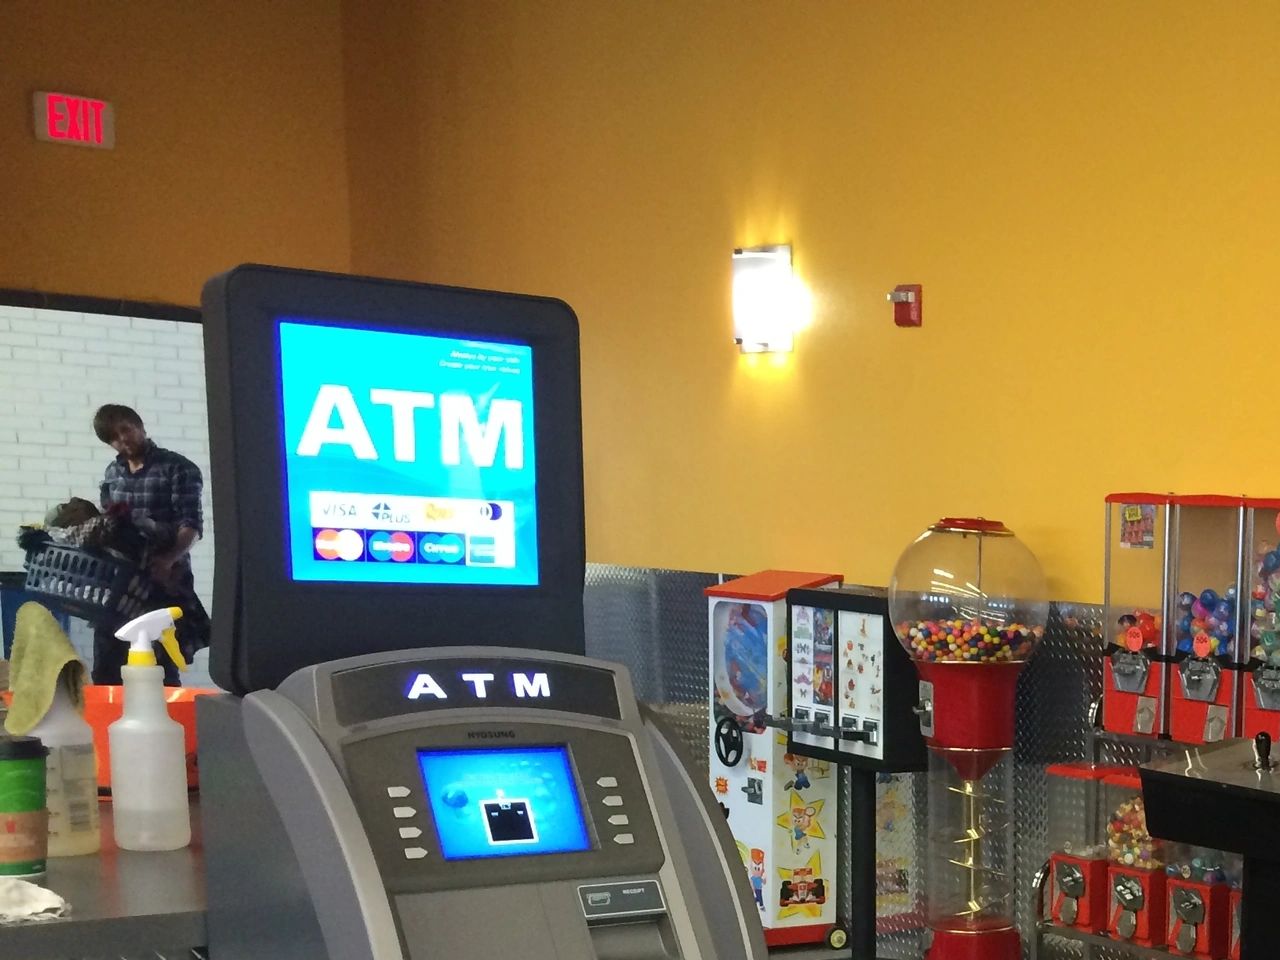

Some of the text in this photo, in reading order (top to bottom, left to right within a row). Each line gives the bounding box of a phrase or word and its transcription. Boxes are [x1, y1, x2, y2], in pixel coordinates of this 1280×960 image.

[47, 93, 106, 144] EXIT
[296, 383, 525, 469] ATM
[323, 503, 357, 517] VISA
[382, 512, 411, 524] PLUS
[407, 672, 552, 699] ATM
